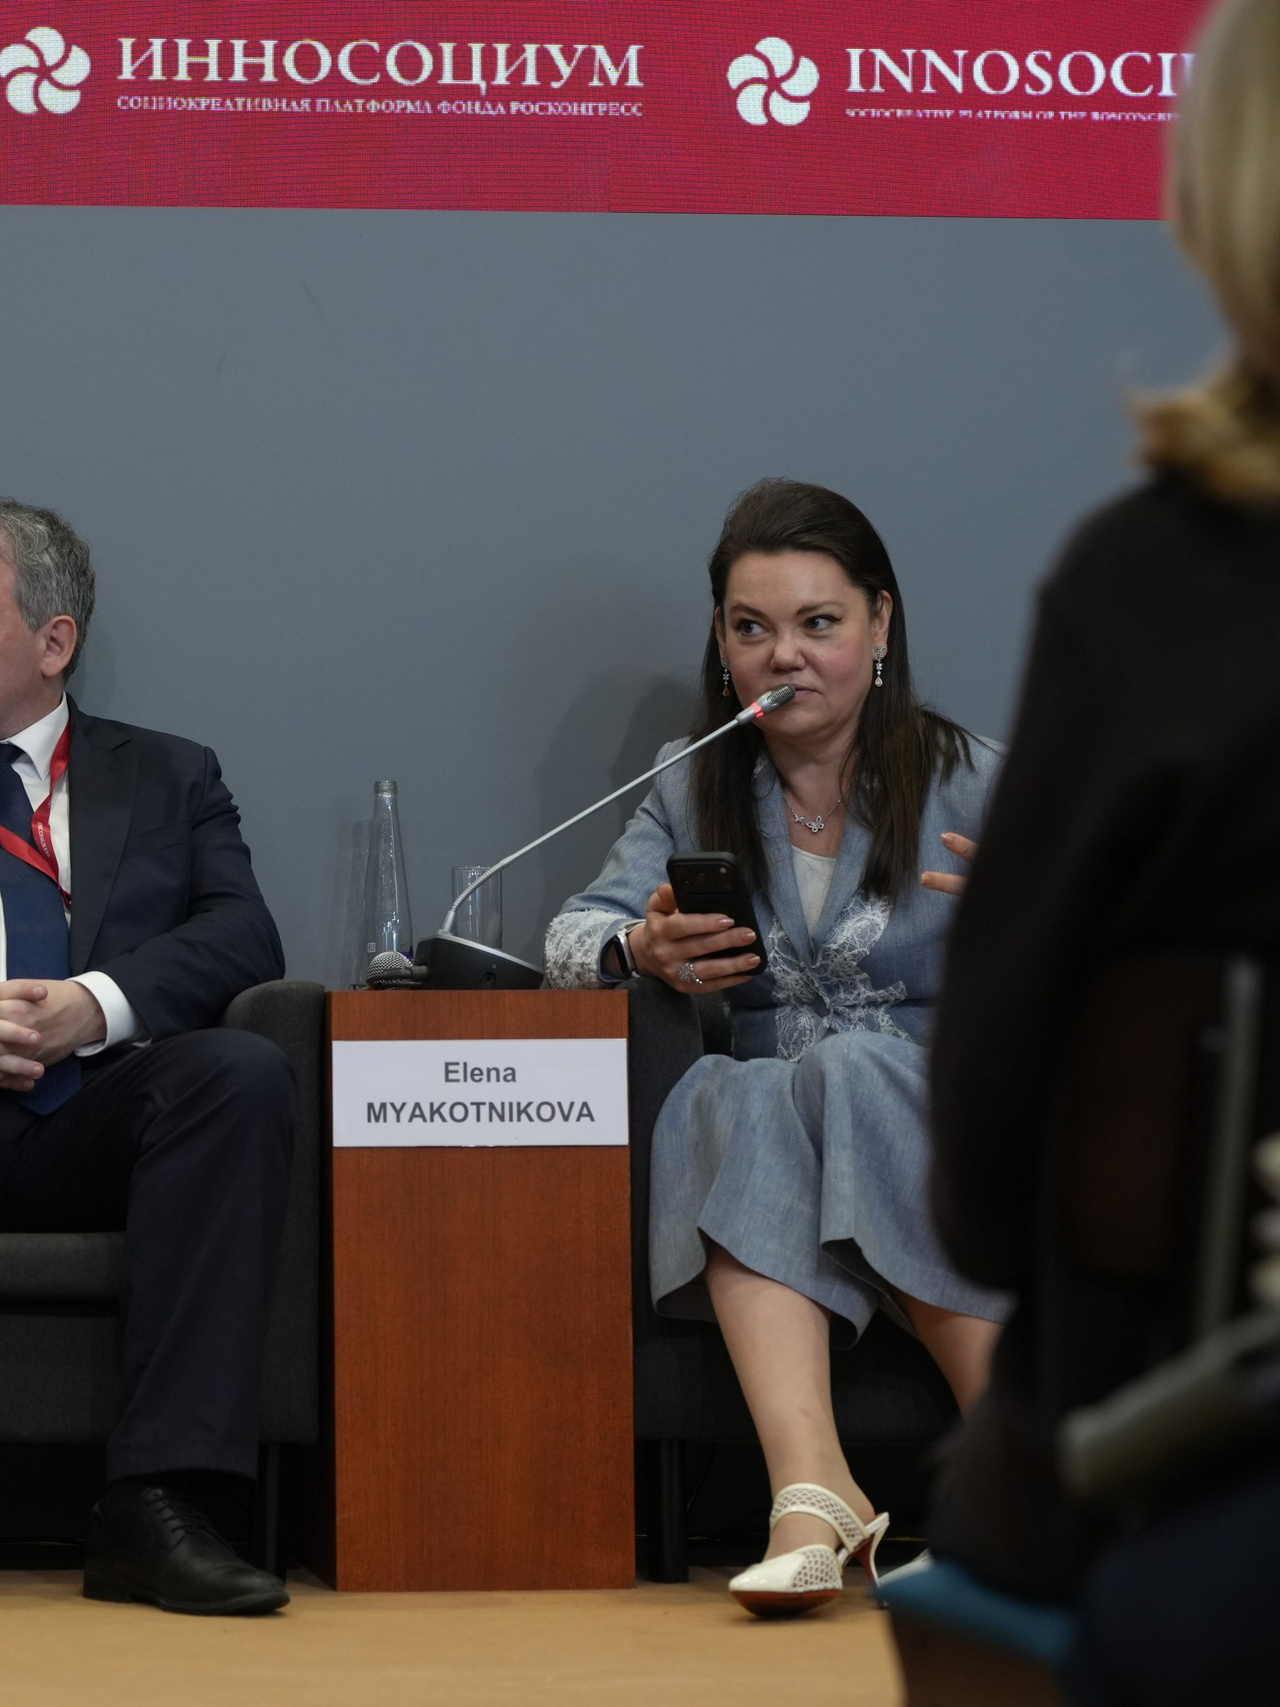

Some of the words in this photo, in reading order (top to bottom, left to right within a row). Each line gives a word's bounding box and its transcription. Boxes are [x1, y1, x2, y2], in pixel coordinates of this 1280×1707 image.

[117, 37, 644, 96] ИННОСОЦИУМ
[315, 98, 433, 114] ПЛАТФОРМА
[437, 99, 506, 117] ФОНДА
[509, 101, 643, 117] РОСКОНГРЕСС
[444, 1061, 517, 1083] Elena
[366, 1101, 596, 1124] MYAKOTNIKOVA
